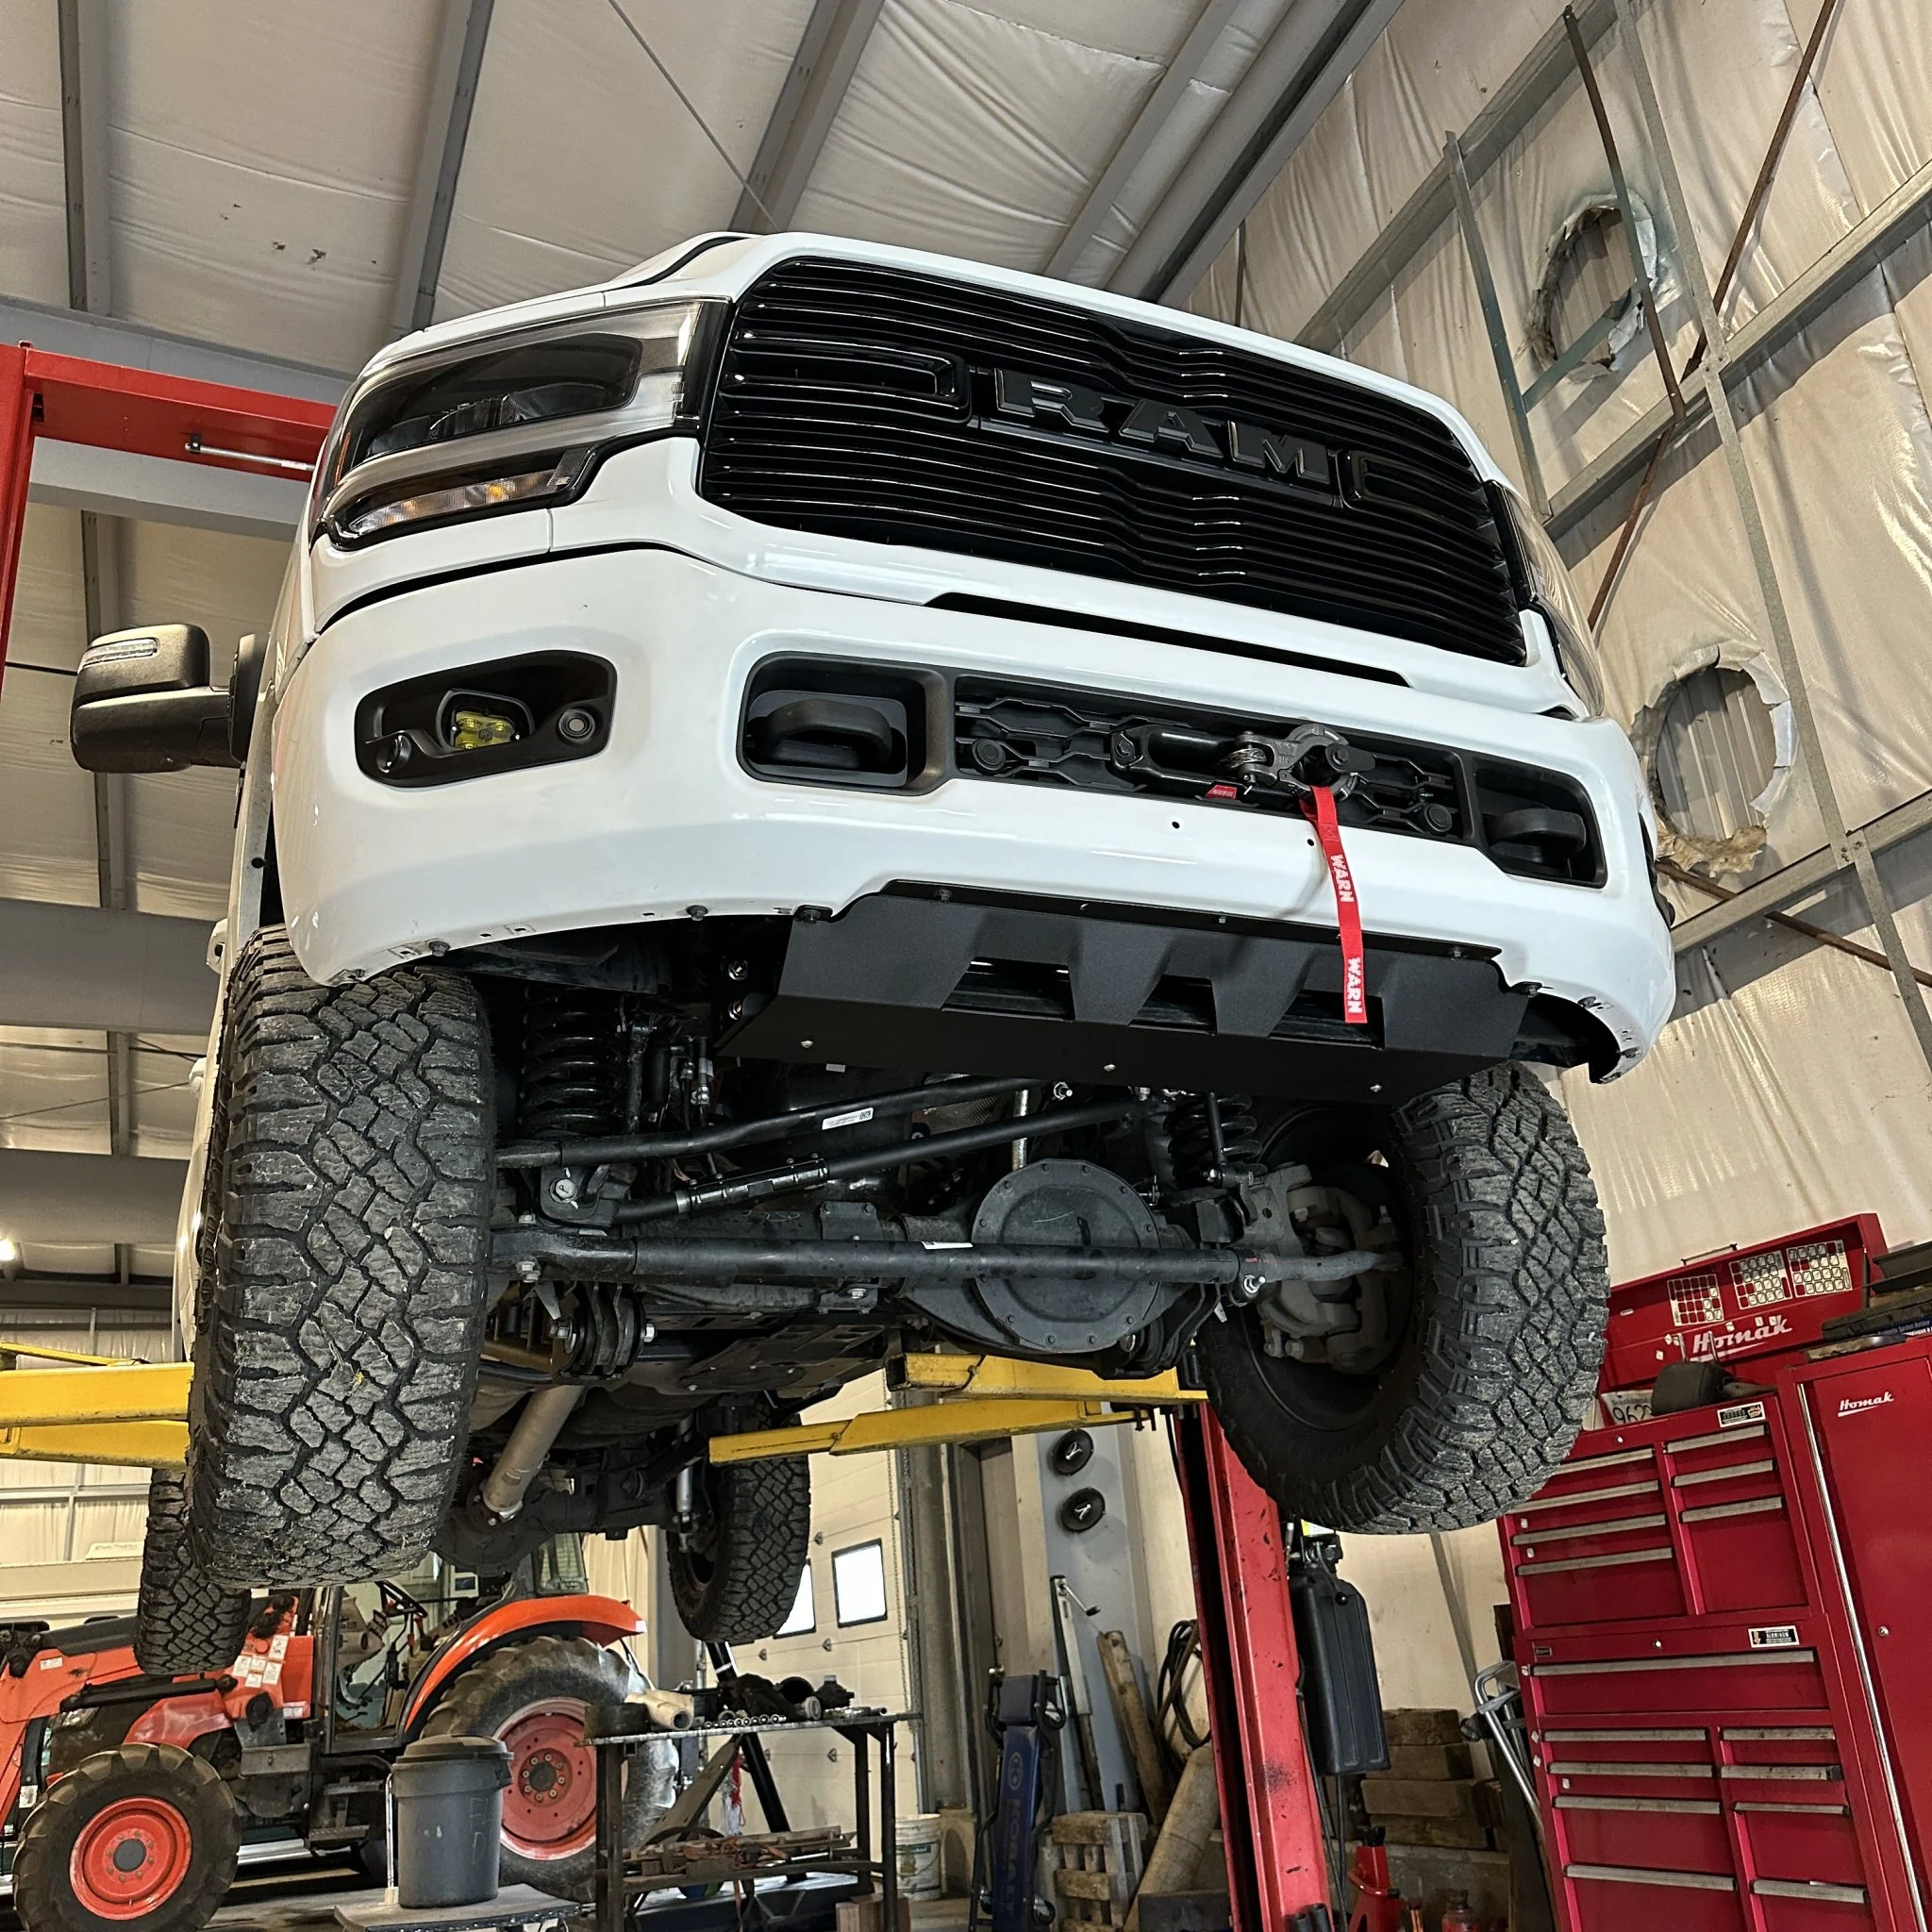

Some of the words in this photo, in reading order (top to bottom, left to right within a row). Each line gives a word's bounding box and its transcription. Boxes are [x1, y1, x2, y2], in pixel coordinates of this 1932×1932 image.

[993, 367, 1331, 485] RAM
[1330, 854, 1354, 903] WARN
[1347, 957, 1362, 1013] WARN
[1692, 1315, 1792, 1355] Homak
[1840, 1391, 1895, 1411] Homak
